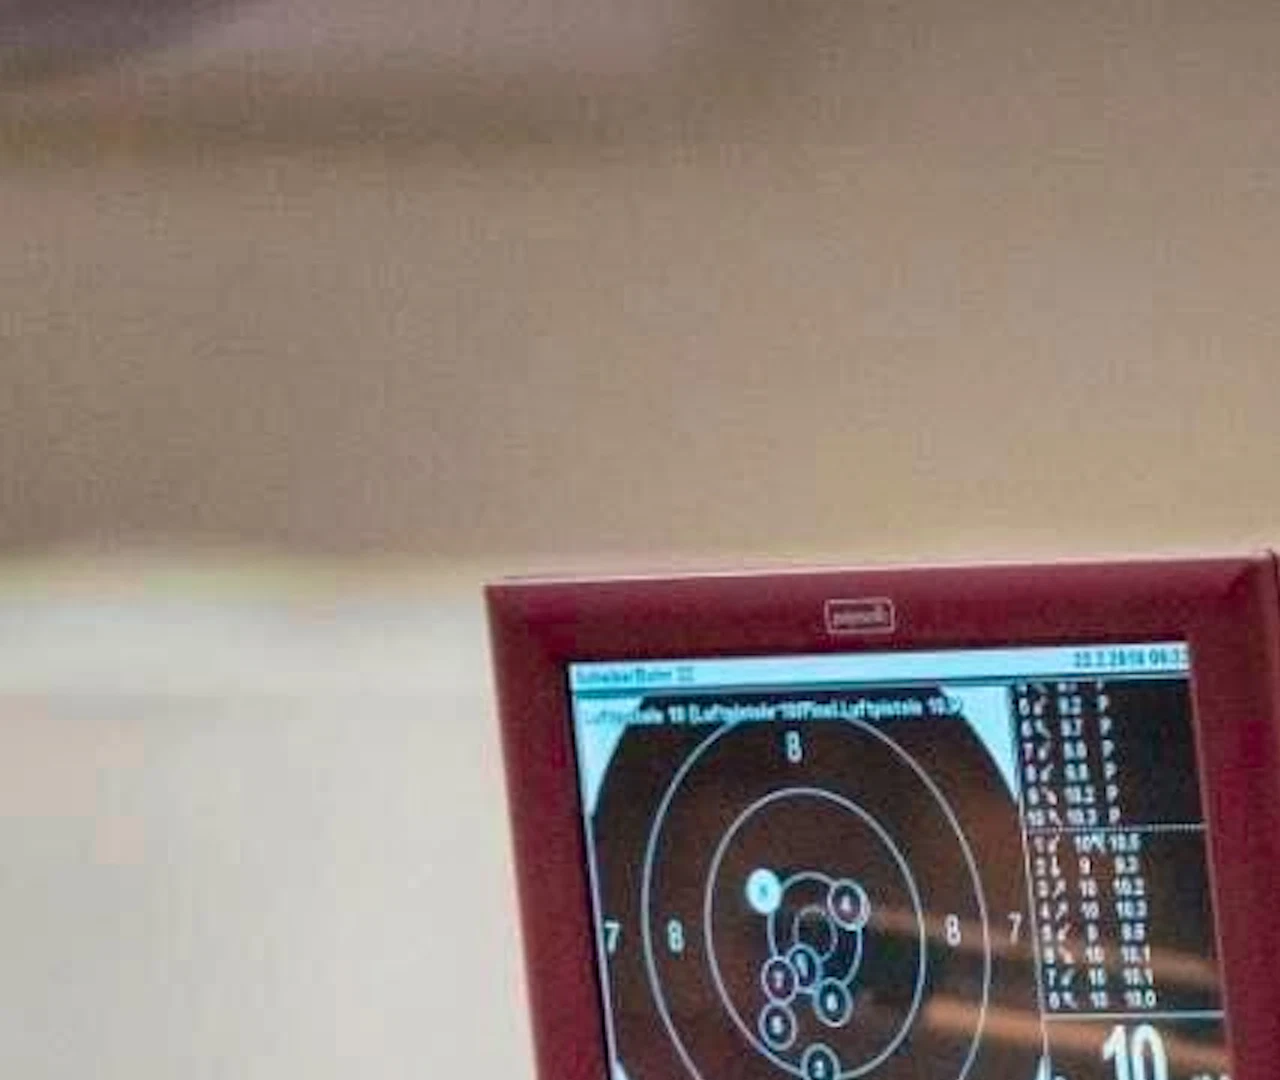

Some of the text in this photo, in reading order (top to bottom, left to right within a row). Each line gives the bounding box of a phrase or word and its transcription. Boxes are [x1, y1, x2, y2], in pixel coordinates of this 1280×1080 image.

[785, 731, 802, 762] 8
[603, 921, 620, 952] 7
[667, 920, 684, 952] 8
[945, 914, 962, 946] 8
[1008, 913, 1022, 944] 7
